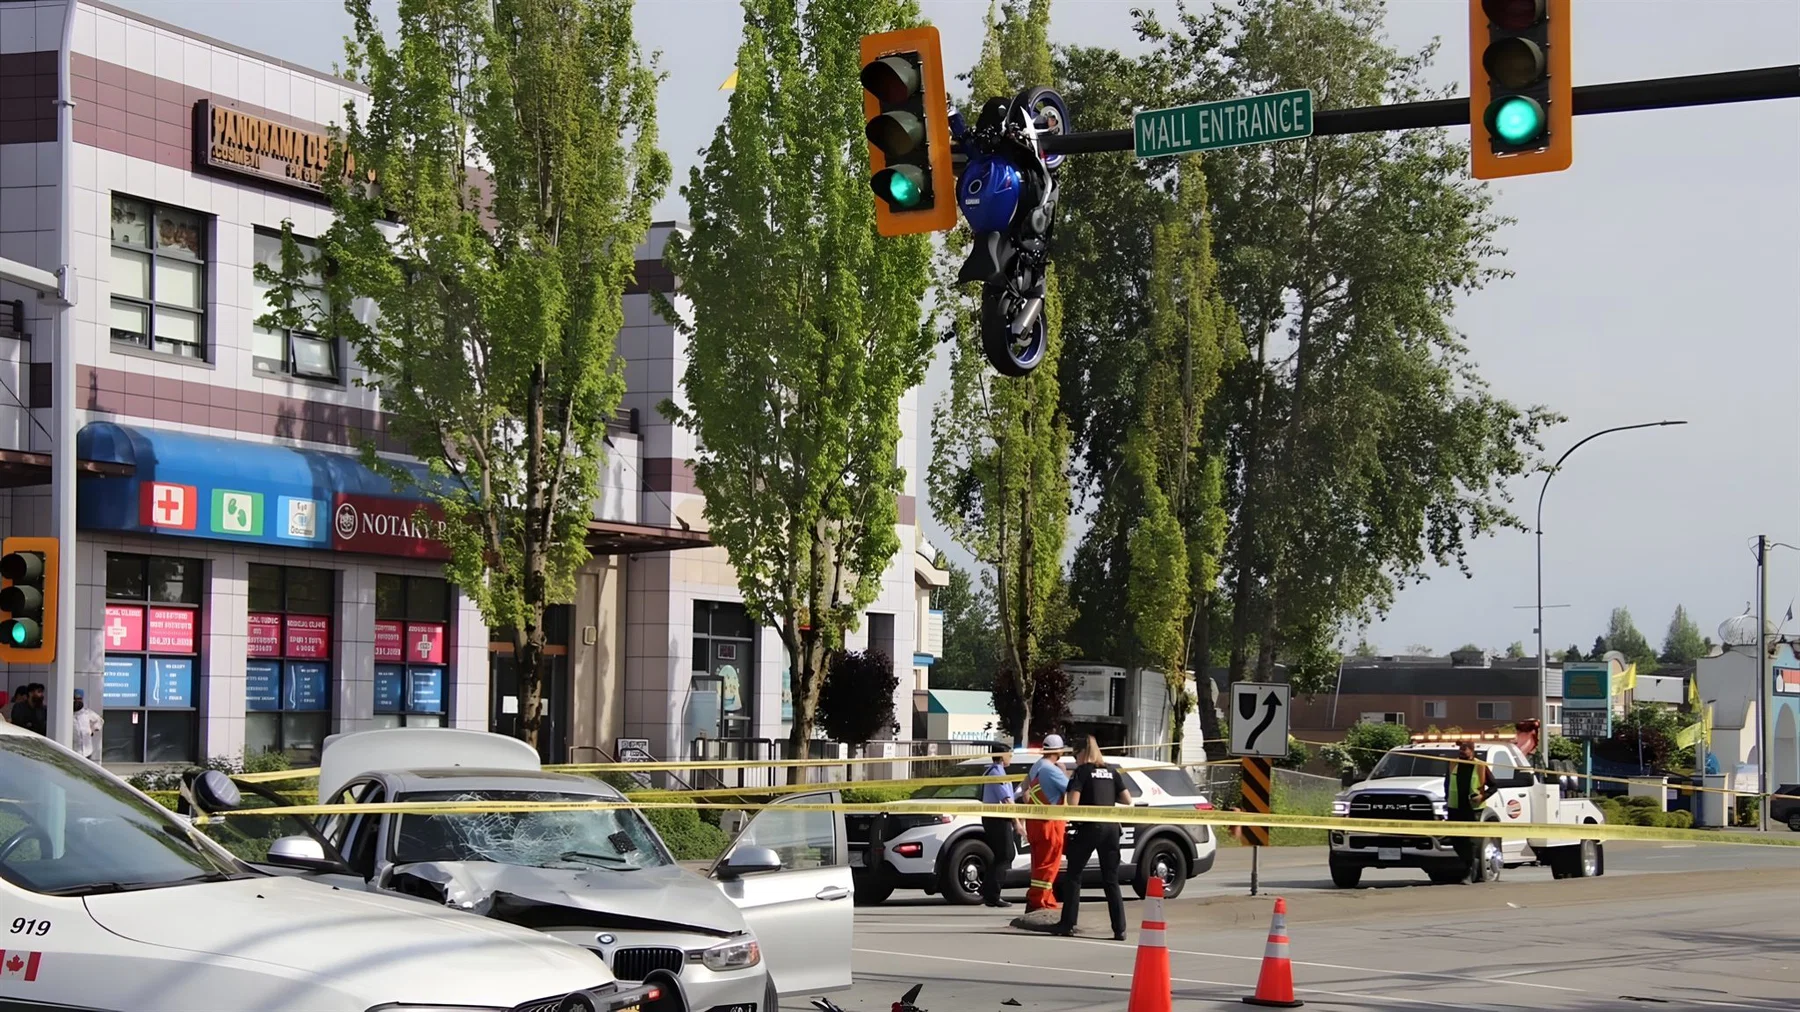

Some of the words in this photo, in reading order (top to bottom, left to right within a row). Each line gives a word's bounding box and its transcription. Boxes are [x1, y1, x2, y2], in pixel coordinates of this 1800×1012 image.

[213, 107, 305, 163] PANORAMA
[1141, 113, 1191, 150] MALL
[1200, 97, 1304, 144] ENTRANCE
[362, 512, 435, 539] NOTARY
[10, 917, 51, 936] 919
